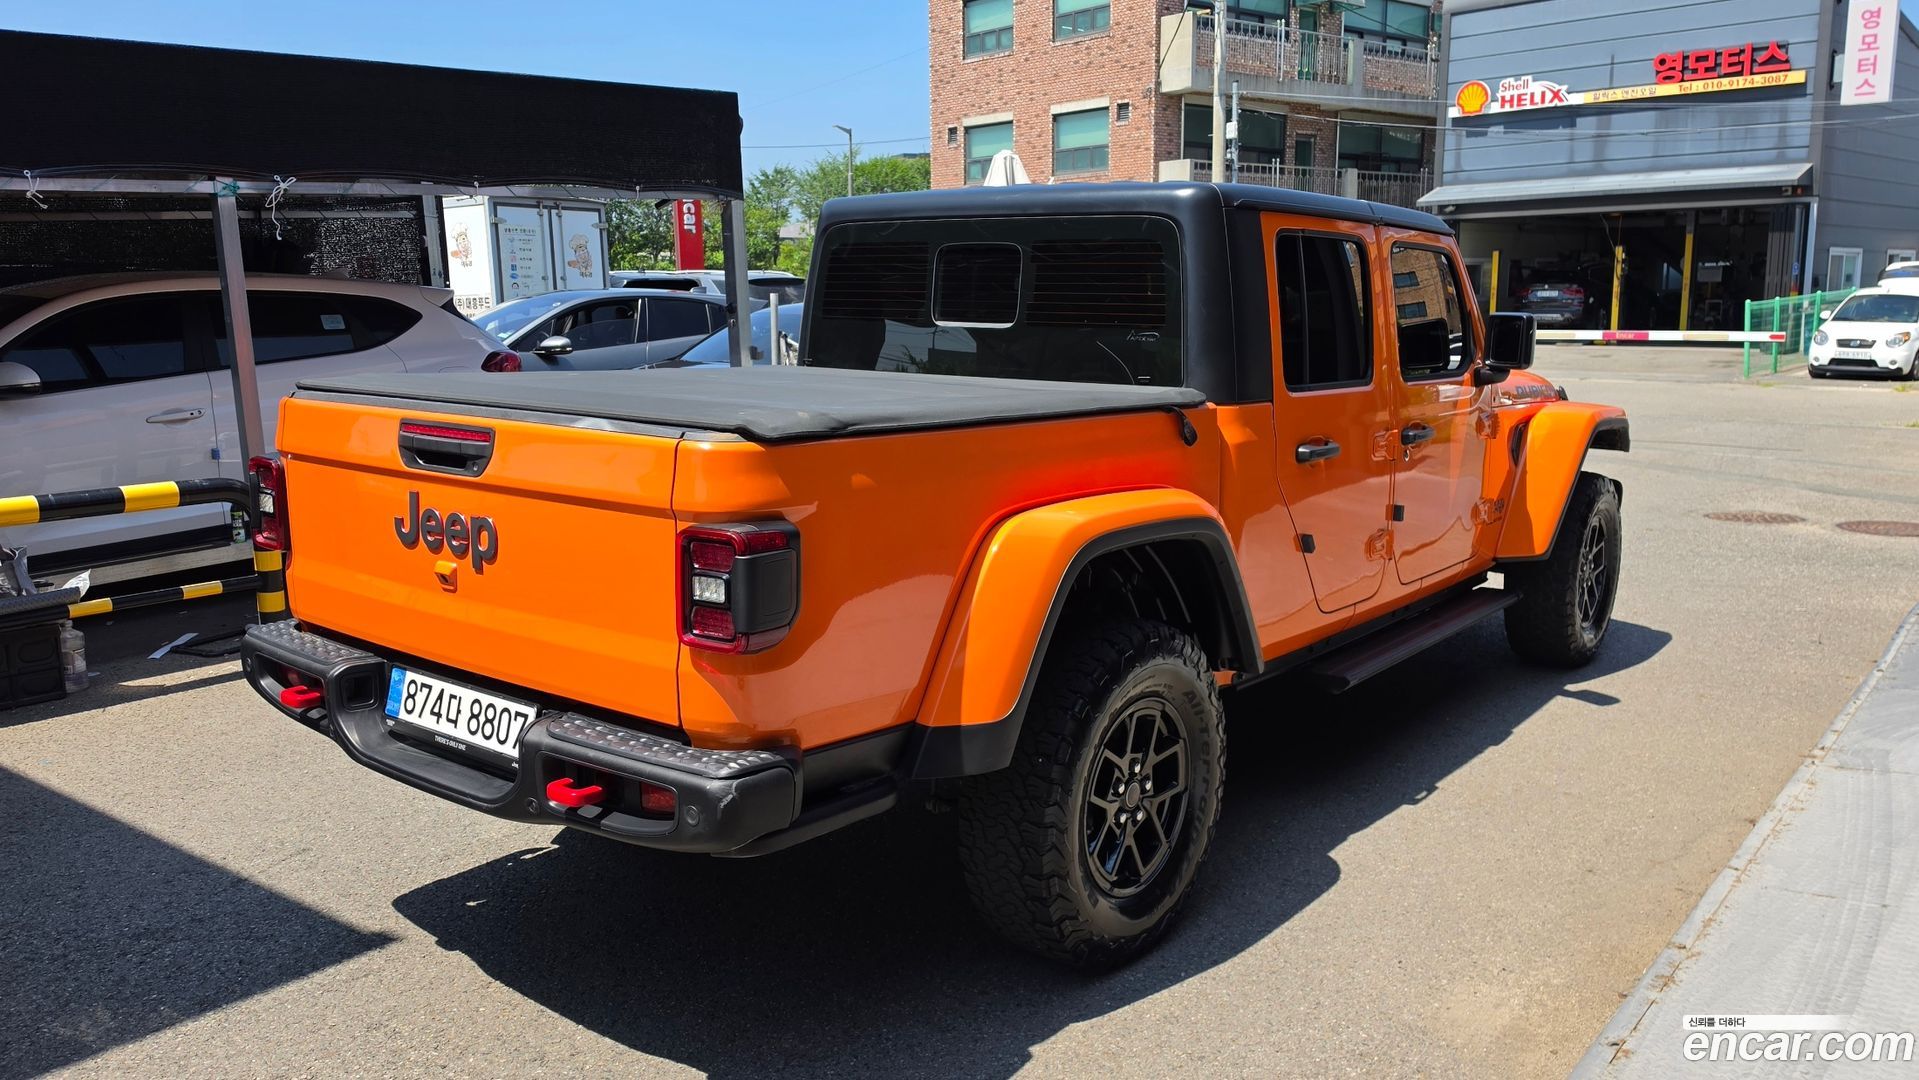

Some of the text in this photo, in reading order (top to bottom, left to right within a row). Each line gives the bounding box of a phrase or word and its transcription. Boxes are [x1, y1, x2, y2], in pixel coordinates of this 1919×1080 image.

[1652, 41, 1790, 84] 영모터스
[1854, 6, 1882, 96] 영모터스
[1499, 86, 1567, 109] HELIX
[1500, 79, 1530, 93] Shell
[1679, 84, 1693, 93] Tel
[1703, 74, 1789, 91] 010-9174-3087
[683, 199, 696, 234] car
[394, 490, 498, 575] Jeep
[404, 679, 529, 750] 874다 8807
